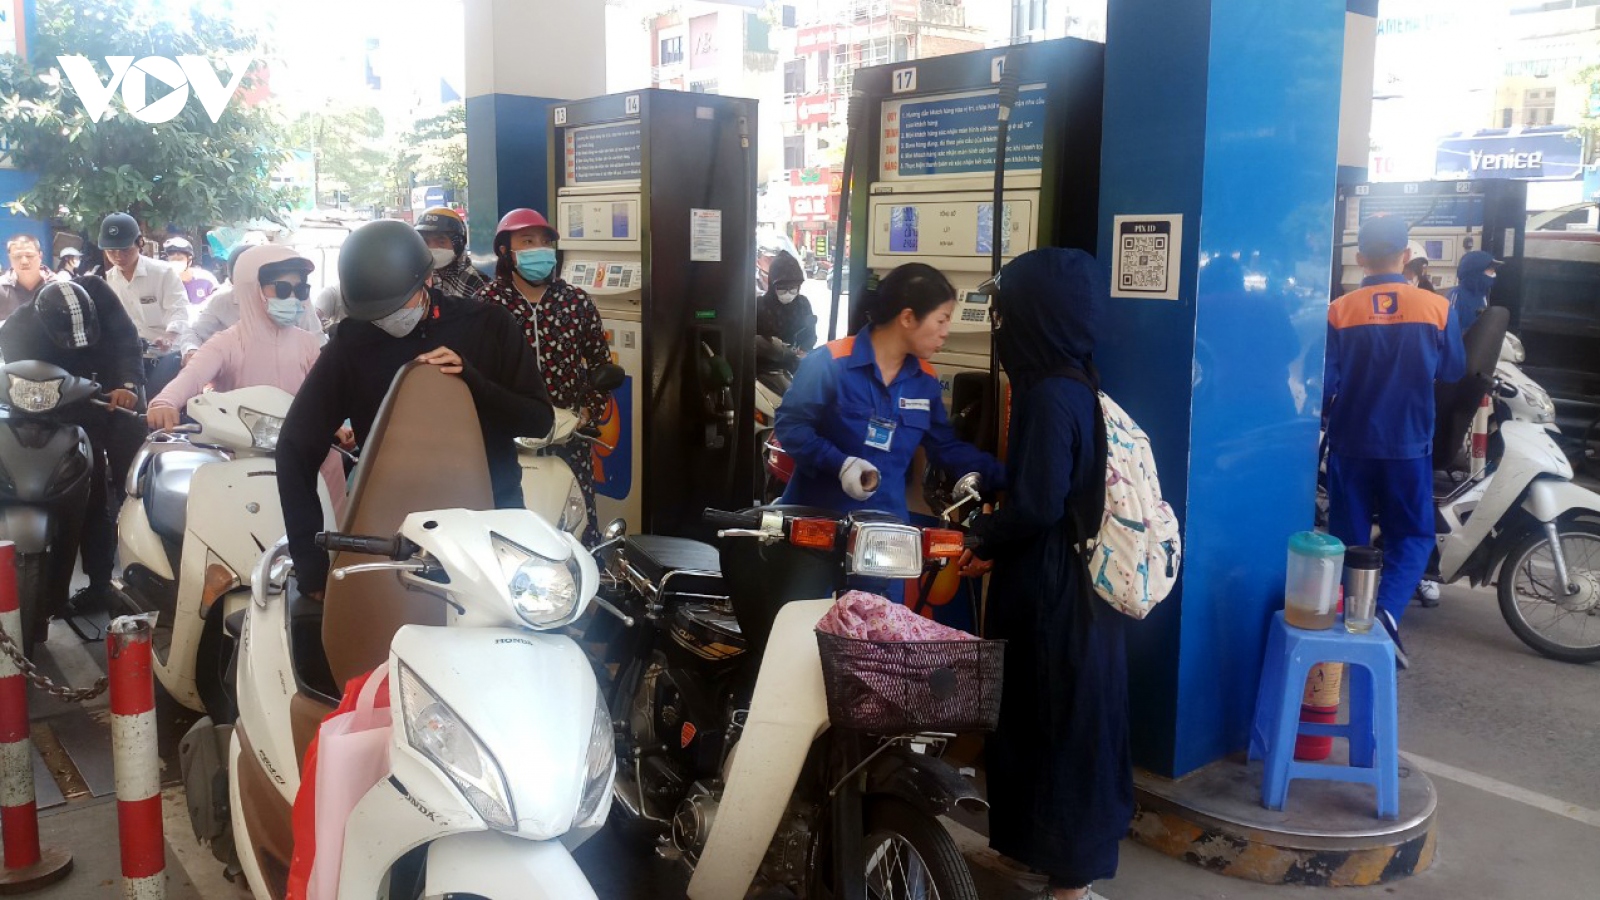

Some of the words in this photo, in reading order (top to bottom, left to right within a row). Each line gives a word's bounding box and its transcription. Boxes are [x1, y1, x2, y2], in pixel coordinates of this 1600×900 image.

[897, 71, 912, 89] 17
[628, 98, 637, 111] 14
[556, 109, 566, 121] 13
[1469, 149, 1543, 171] Venice
